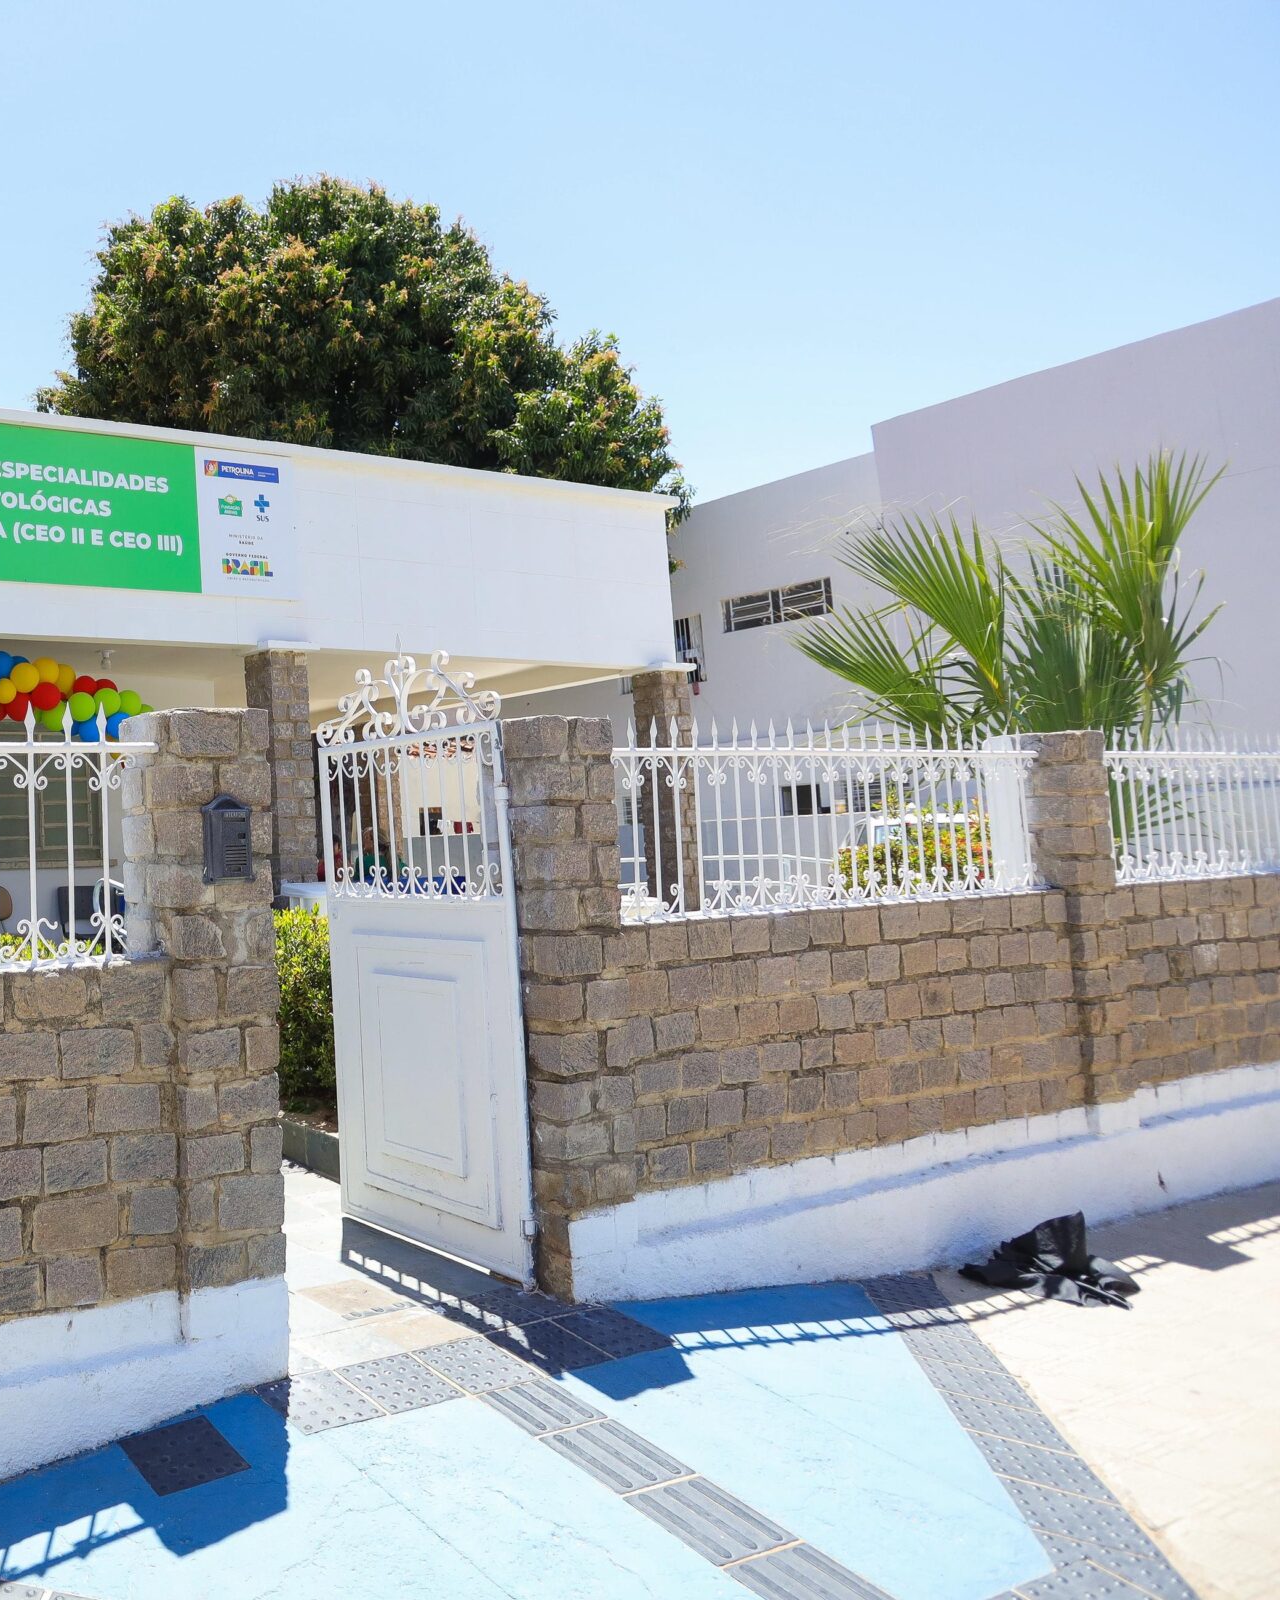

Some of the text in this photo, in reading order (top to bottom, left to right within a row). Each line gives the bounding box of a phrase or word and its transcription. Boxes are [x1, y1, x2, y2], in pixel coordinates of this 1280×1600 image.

[221, 465, 254, 476] PETROLINA
[256, 514, 270, 523] SUS
[13, 521, 65, 544] (CEO
[71, 527, 84, 544] II
[91, 529, 104, 546] E
[109, 530, 151, 550] CEO
[157, 534, 183, 556] III)
[222, 558, 273, 577] BRASIL
